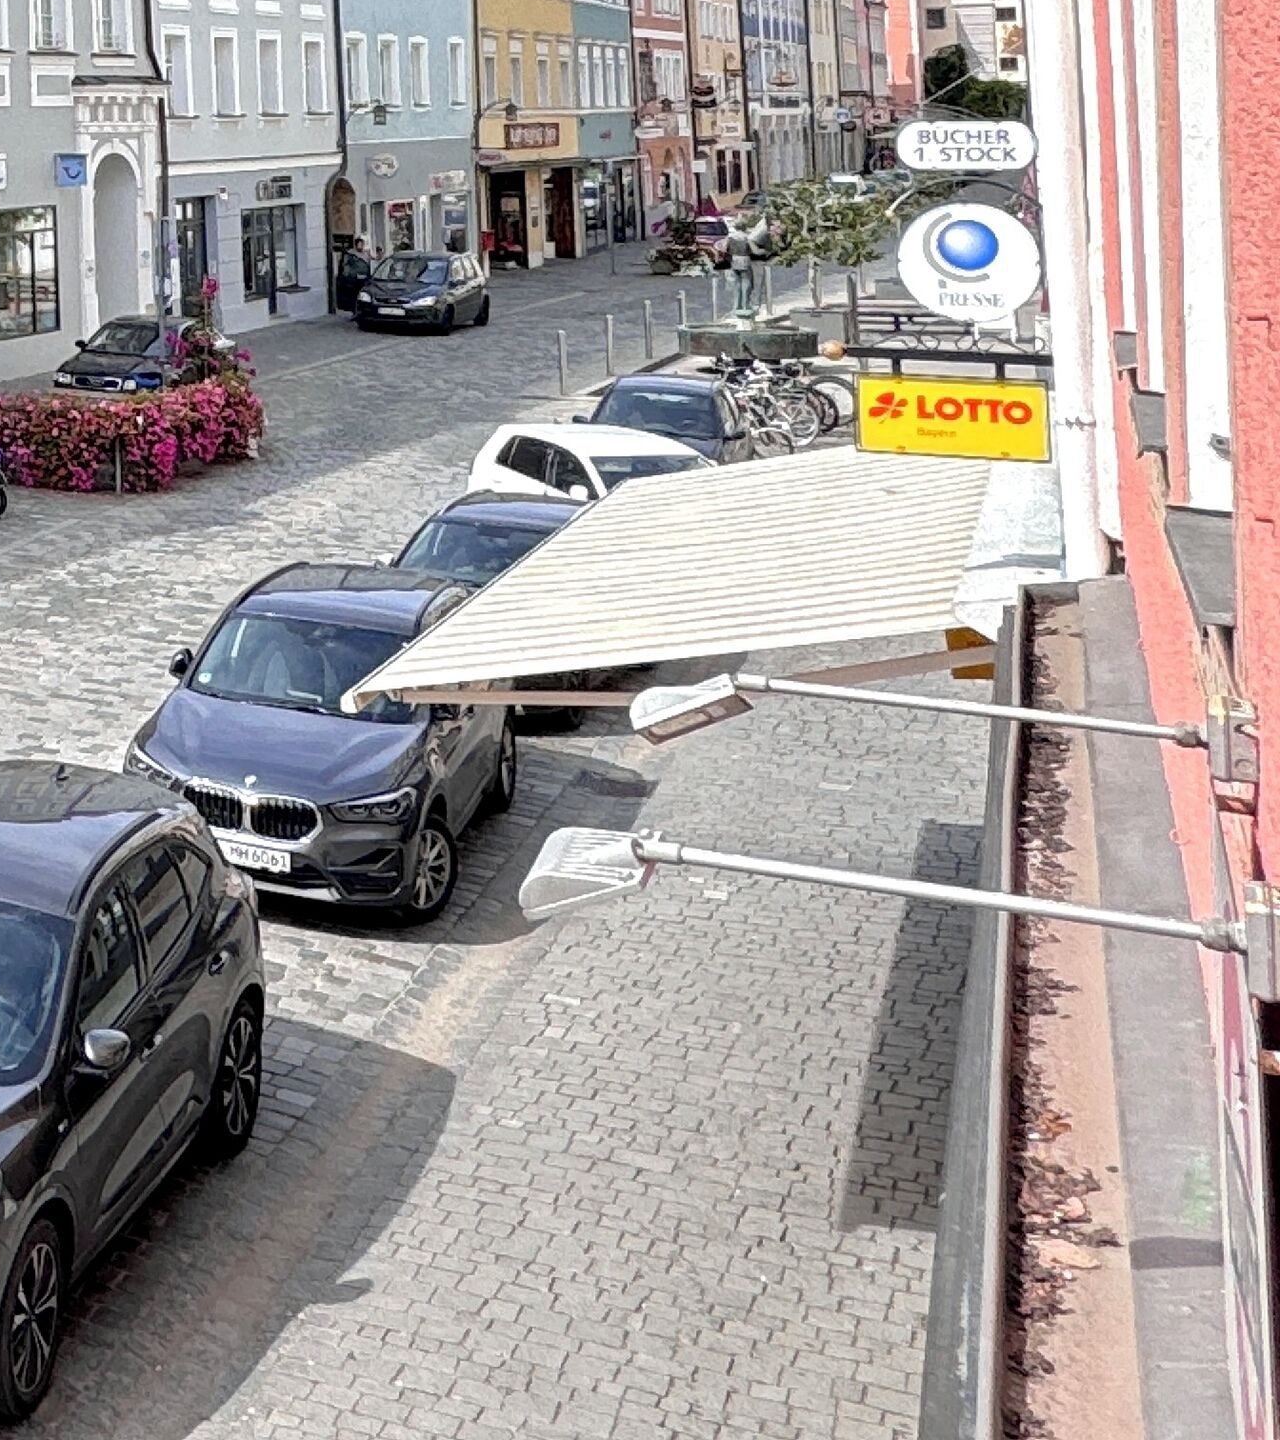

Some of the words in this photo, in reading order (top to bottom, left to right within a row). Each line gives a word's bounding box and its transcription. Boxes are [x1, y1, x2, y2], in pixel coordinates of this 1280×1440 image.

[941, 147, 1017, 163] STOCK
[939, 292, 1005, 308] PRESSE
[916, 395, 1032, 425] LOTTO
